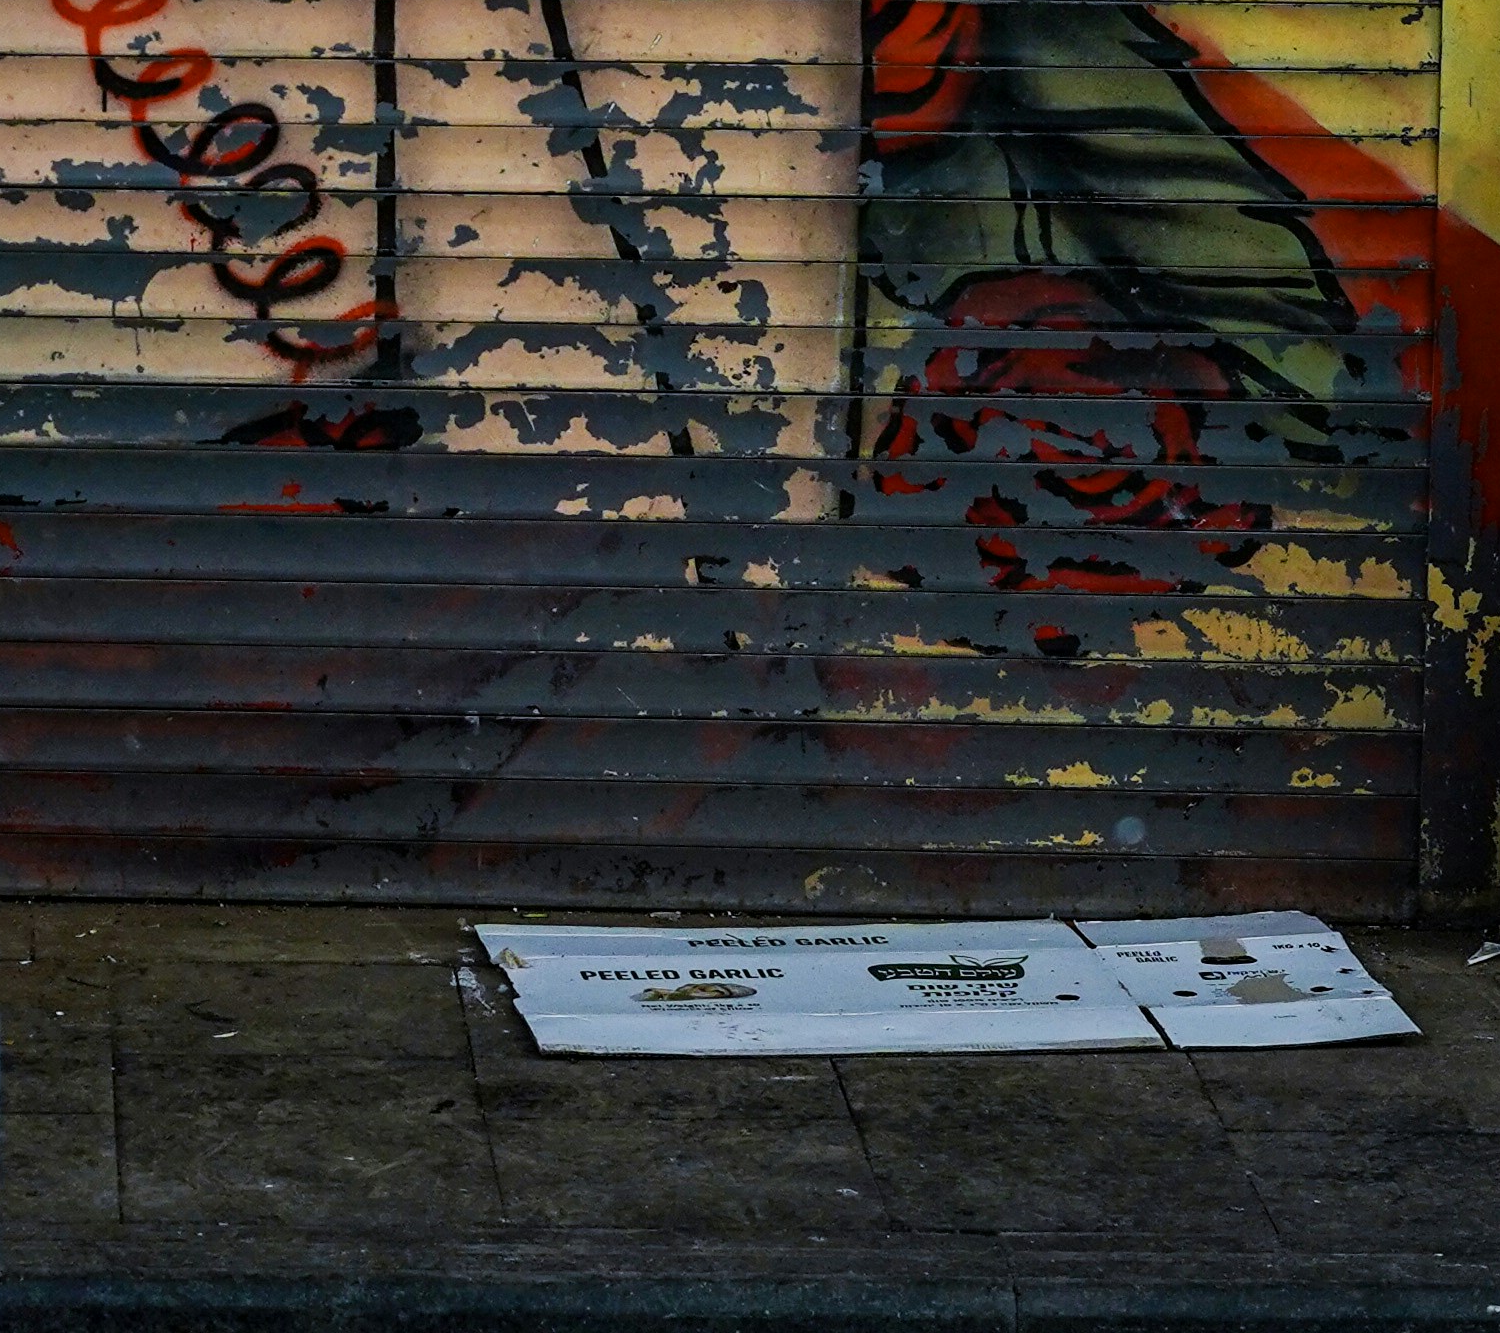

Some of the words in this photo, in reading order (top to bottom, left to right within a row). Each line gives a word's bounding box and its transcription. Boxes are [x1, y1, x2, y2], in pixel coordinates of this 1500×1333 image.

[688, 937, 788, 948] PEELED
[794, 935, 890, 946] GARLIC
[580, 969, 681, 981] PEELED
[689, 967, 785, 980] GARLIC
[877, 967, 953, 980] הטבע
[958, 967, 1017, 979] עולם
